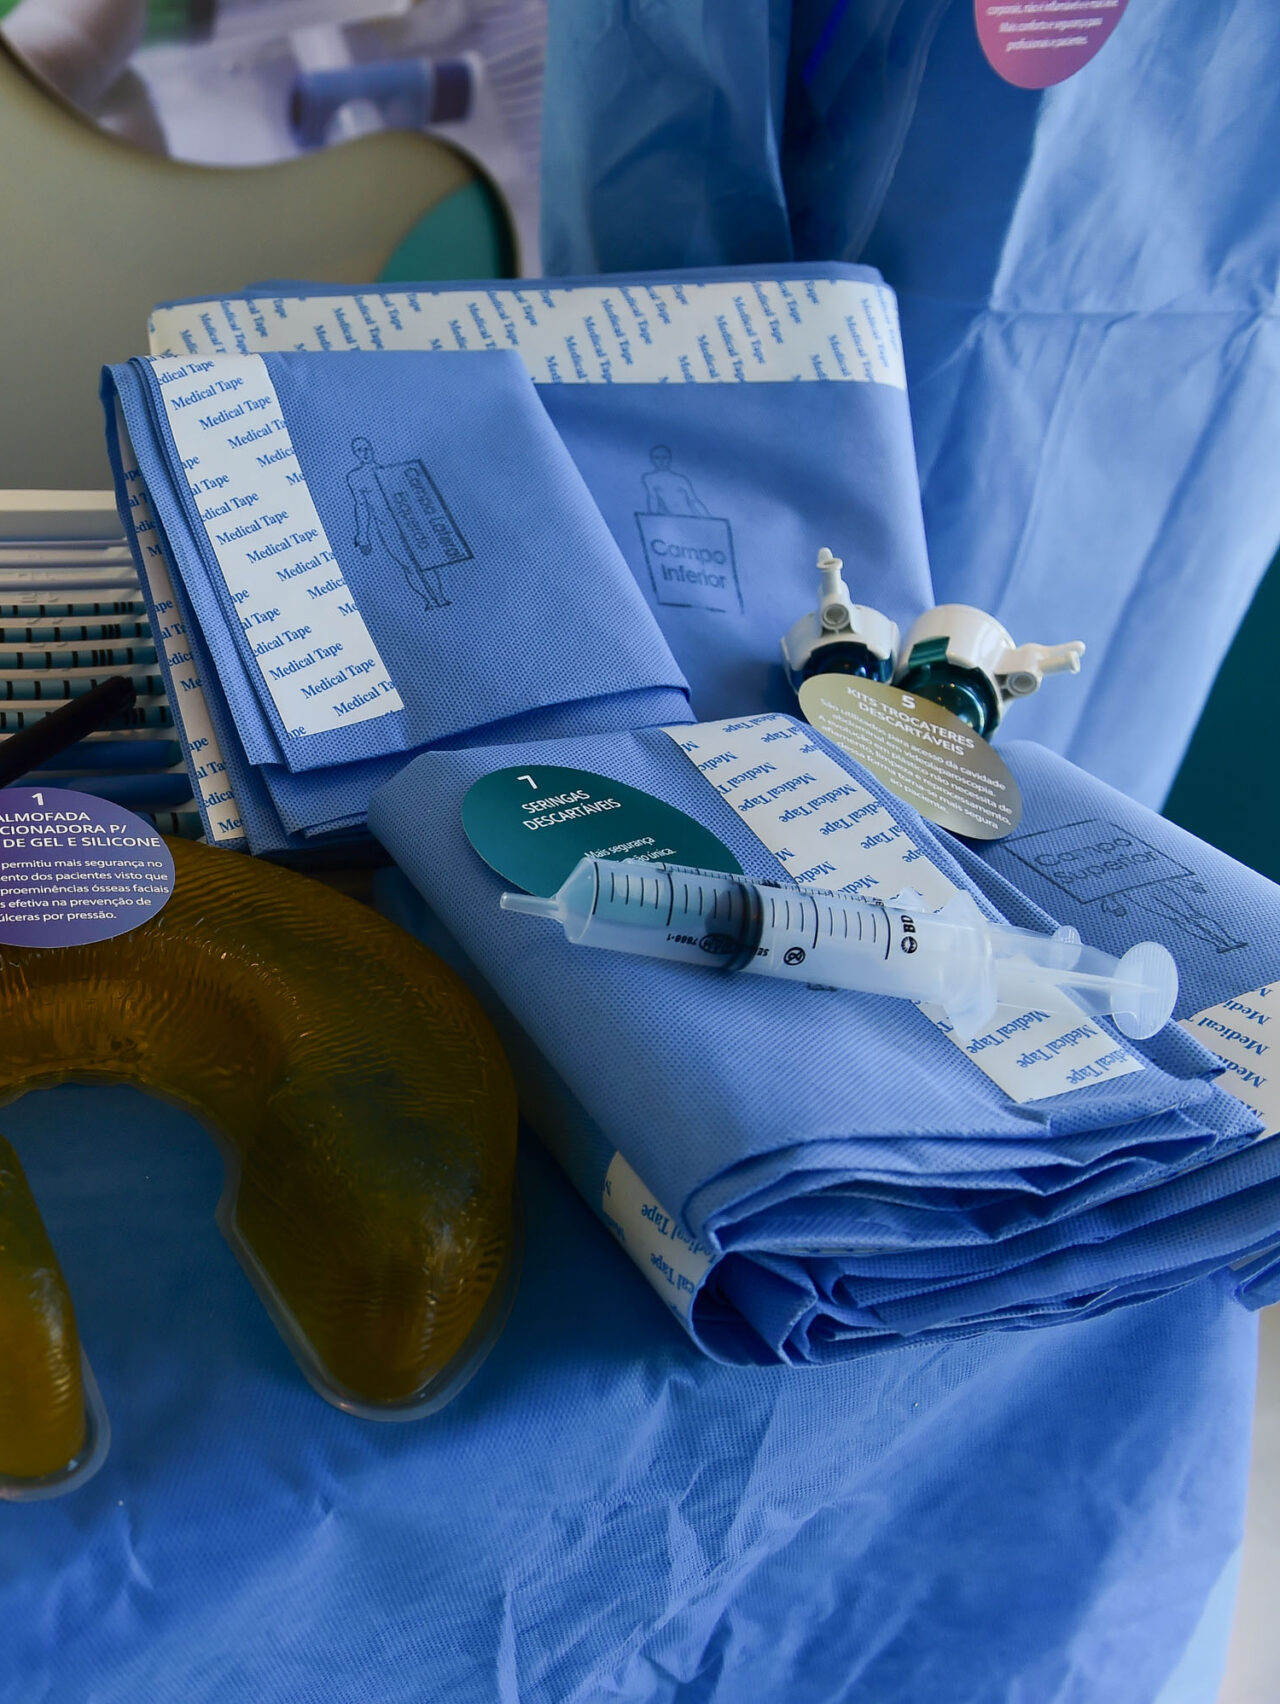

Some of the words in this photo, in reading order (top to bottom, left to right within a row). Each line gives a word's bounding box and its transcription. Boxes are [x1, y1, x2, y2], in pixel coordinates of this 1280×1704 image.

[186, 360, 216, 375] Tape
[171, 385, 217, 411] Medical
[215, 376, 244, 393] Tape
[227, 423, 273, 450] Medical
[200, 473, 231, 491] Tape
[230, 491, 260, 510] Tape
[215, 519, 262, 546] Medical
[260, 509, 290, 528] Tape
[650, 538, 727, 565] Campo
[275, 555, 323, 582] Medical
[251, 606, 281, 626] Tape
[281, 624, 312, 643] Tape
[268, 653, 316, 681] Medical
[313, 641, 344, 661] Tape
[300, 671, 348, 699] Medical
[345, 658, 376, 677] Tape
[332, 688, 381, 717] Medical
[901, 694, 916, 710] 5
[846, 687, 880, 706] KITS
[881, 700, 975, 750] TROCATERES
[760, 729, 792, 743] Tape
[858, 702, 966, 756] DESCARTÁVEIS
[517, 774, 538, 790] 7
[727, 762, 778, 789] Medical
[768, 773, 817, 799] Medical
[32, 792, 44, 806] 1
[521, 789, 591, 814] SERINGAS
[738, 794, 773, 812] Tape
[522, 798, 622, 831] DESCARTÁVEIS
[110, 824, 127, 834] P/
[819, 818, 853, 836] Tape
[3, 838, 26, 849] DE
[30, 837, 64, 848] GEL
[67, 837, 78, 847] E
[81, 836, 161, 848] SILICONE
[608, 837, 655, 853] segurança
[860, 832, 894, 850] Tape
[1034, 838, 1133, 867] Campo
[1, 859, 52, 870] permitiu
[54, 858, 82, 868] mais
[84, 859, 145, 869] segurança
[147, 860, 163, 868] no
[1053, 850, 1160, 885] Superior
[31, 872, 53, 881] dos
[55, 871, 112, 884] pacientes
[114, 871, 142, 880] visto
[145, 873, 169, 882] que
[0, 884, 90, 897] proeminências
[92, 883, 131, 893] ósseas
[133, 884, 170, 894] faciais
[8, 898, 50, 909] efetiva
[52, 899, 68, 907] na
[70, 897, 134, 909] prevenção
[136, 897, 152, 906] de
[43, 912, 64, 922] por
[66, 910, 117, 922] pressão.
[901, 915, 916, 933] BD
[996, 1010, 1051, 1040] Medical
[966, 1034, 1004, 1054] Tape
[1197, 1017, 1271, 1056] Medical
[1066, 1064, 1103, 1084] Tape
[641, 1204, 670, 1236] Tape
